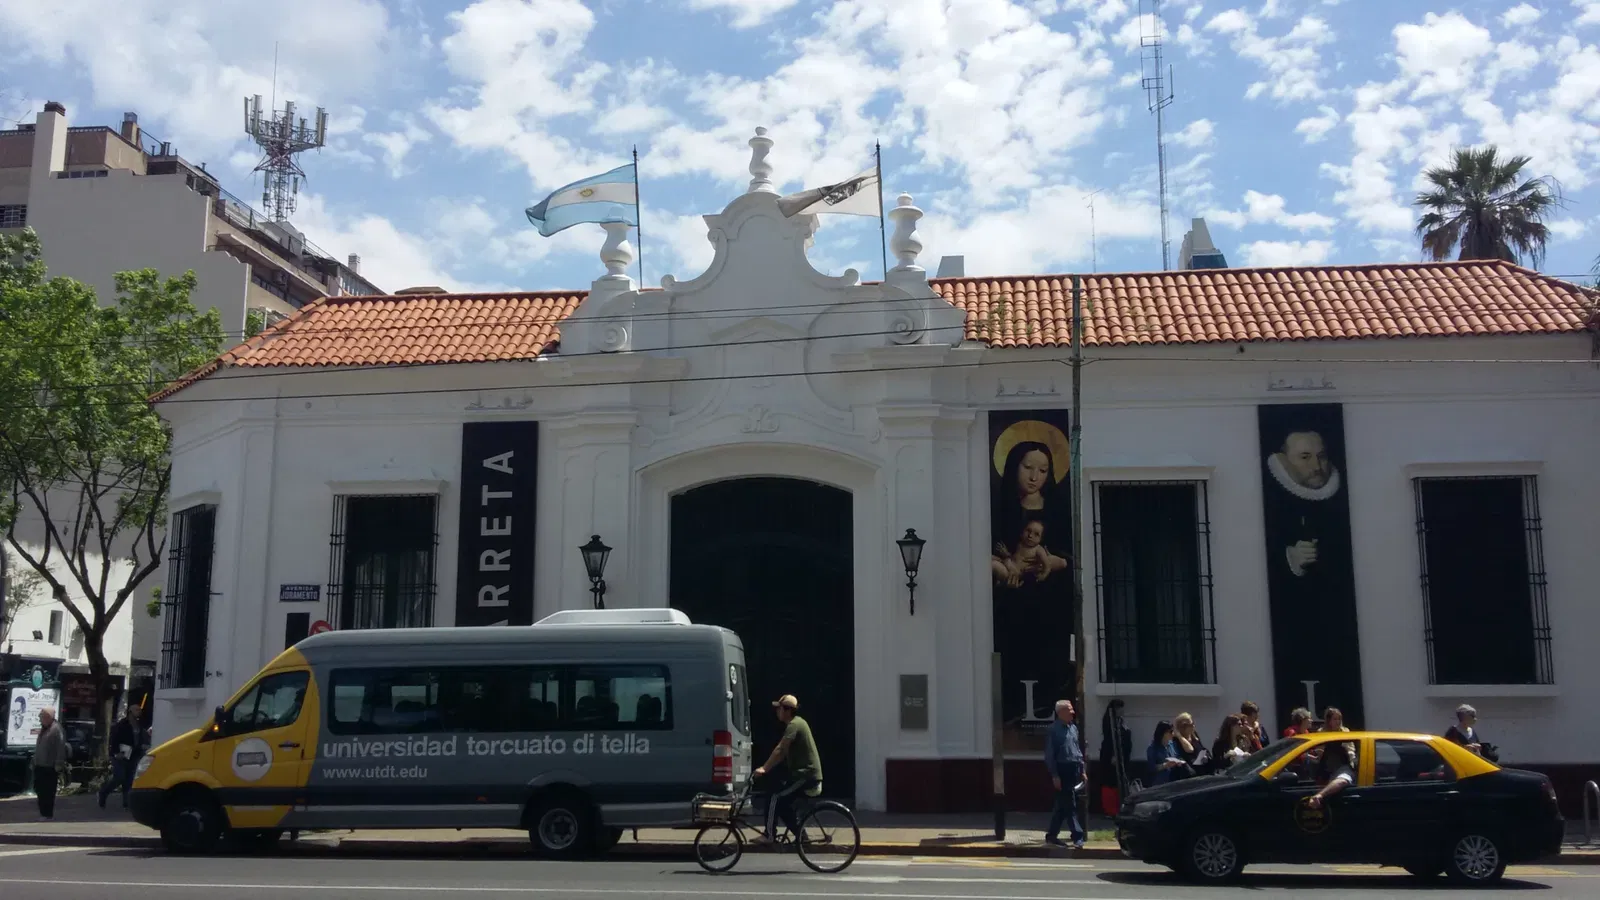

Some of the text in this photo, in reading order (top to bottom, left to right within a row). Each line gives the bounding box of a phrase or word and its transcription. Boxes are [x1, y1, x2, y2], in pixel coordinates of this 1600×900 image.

[477, 450, 515, 627] RRETA
[281, 591, 318, 600] JURAMENTO
[323, 733, 650, 758] universidad torcuato di tella
[322, 765, 428, 779] www.utdt.edu
